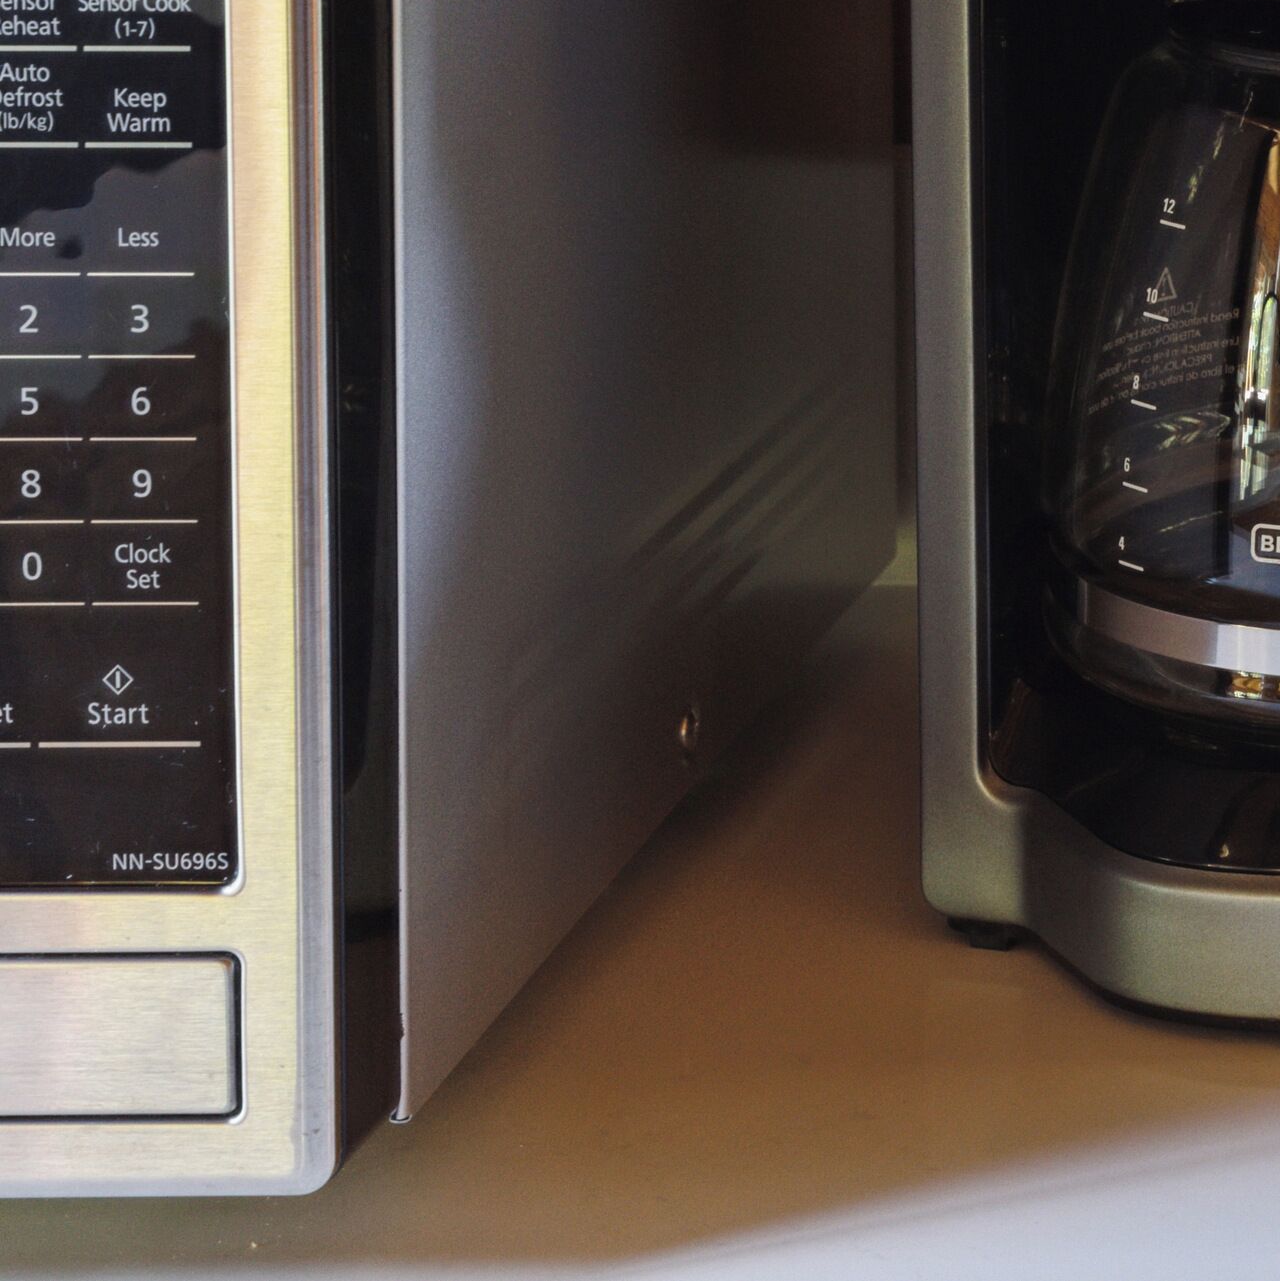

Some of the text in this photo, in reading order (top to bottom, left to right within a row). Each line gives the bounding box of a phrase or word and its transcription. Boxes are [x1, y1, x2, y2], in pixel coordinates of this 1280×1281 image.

[0, 16, 60, 36] eheat
[115, 18, 155, 39] (1-7)
[0, 63, 50, 82] Auto
[0, 86, 64, 107] efrost
[114, 88, 167, 112] Keep
[107, 113, 171, 132] Warm
[1162, 198, 1176, 214] 12
[0, 227, 55, 247] More
[118, 227, 159, 247] Less
[1146, 288, 1158, 304] 10
[19, 305, 39, 333] 2
[130, 305, 151, 333] 3
[1132, 375, 1139, 389] 8
[20, 388, 39, 416] 5
[131, 387, 151, 416] 6
[1124, 457, 1131, 473] 6
[20, 470, 42, 499] 8
[131, 469, 152, 498] 9
[1118, 535, 1125, 551] 4
[115, 543, 172, 564] Clock
[22, 552, 42, 580] 0
[127, 569, 160, 589] Set
[88, 702, 150, 724] Start
[112, 852, 228, 870] NN-SU696S
